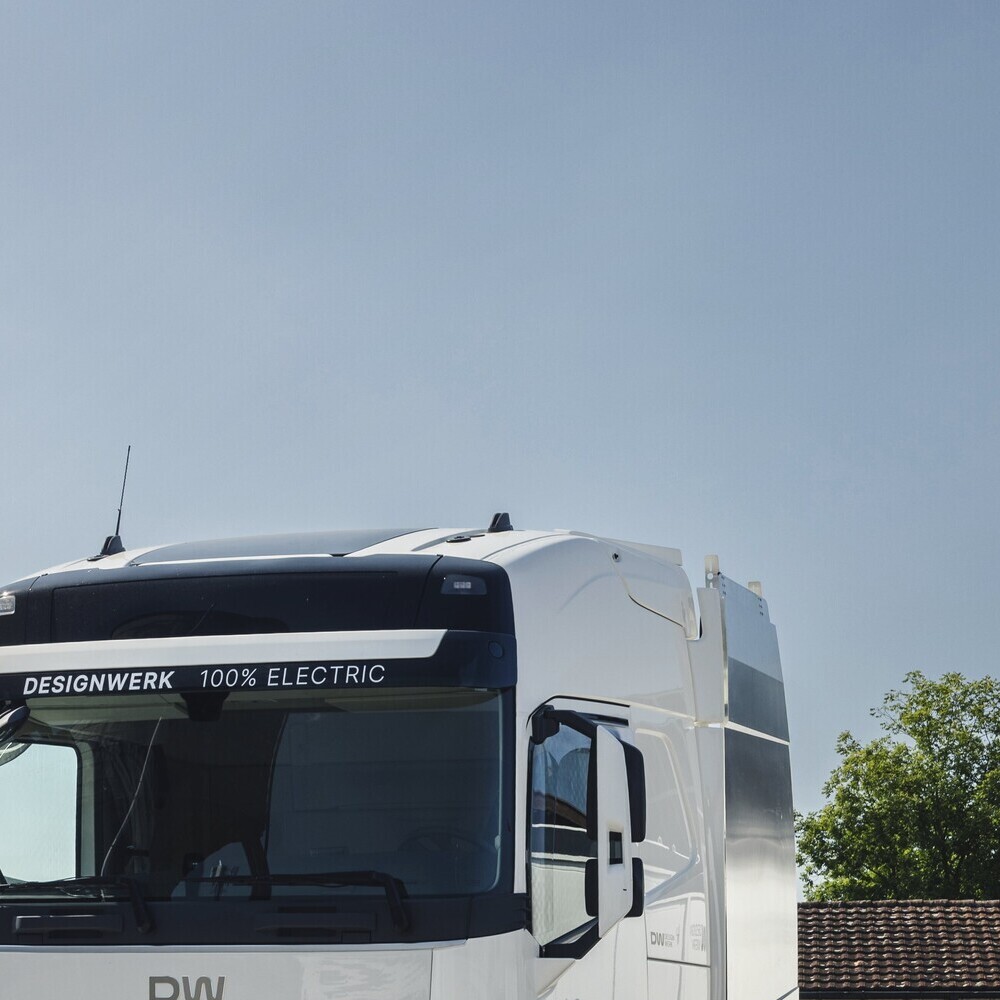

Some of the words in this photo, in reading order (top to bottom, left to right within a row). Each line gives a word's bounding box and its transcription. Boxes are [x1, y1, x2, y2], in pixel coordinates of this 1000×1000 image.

[23, 670, 175, 695] DESIGNWERK
[200, 668, 257, 688] 100%
[267, 664, 386, 686] ELECTRIC
[650, 932, 664, 946] DW
